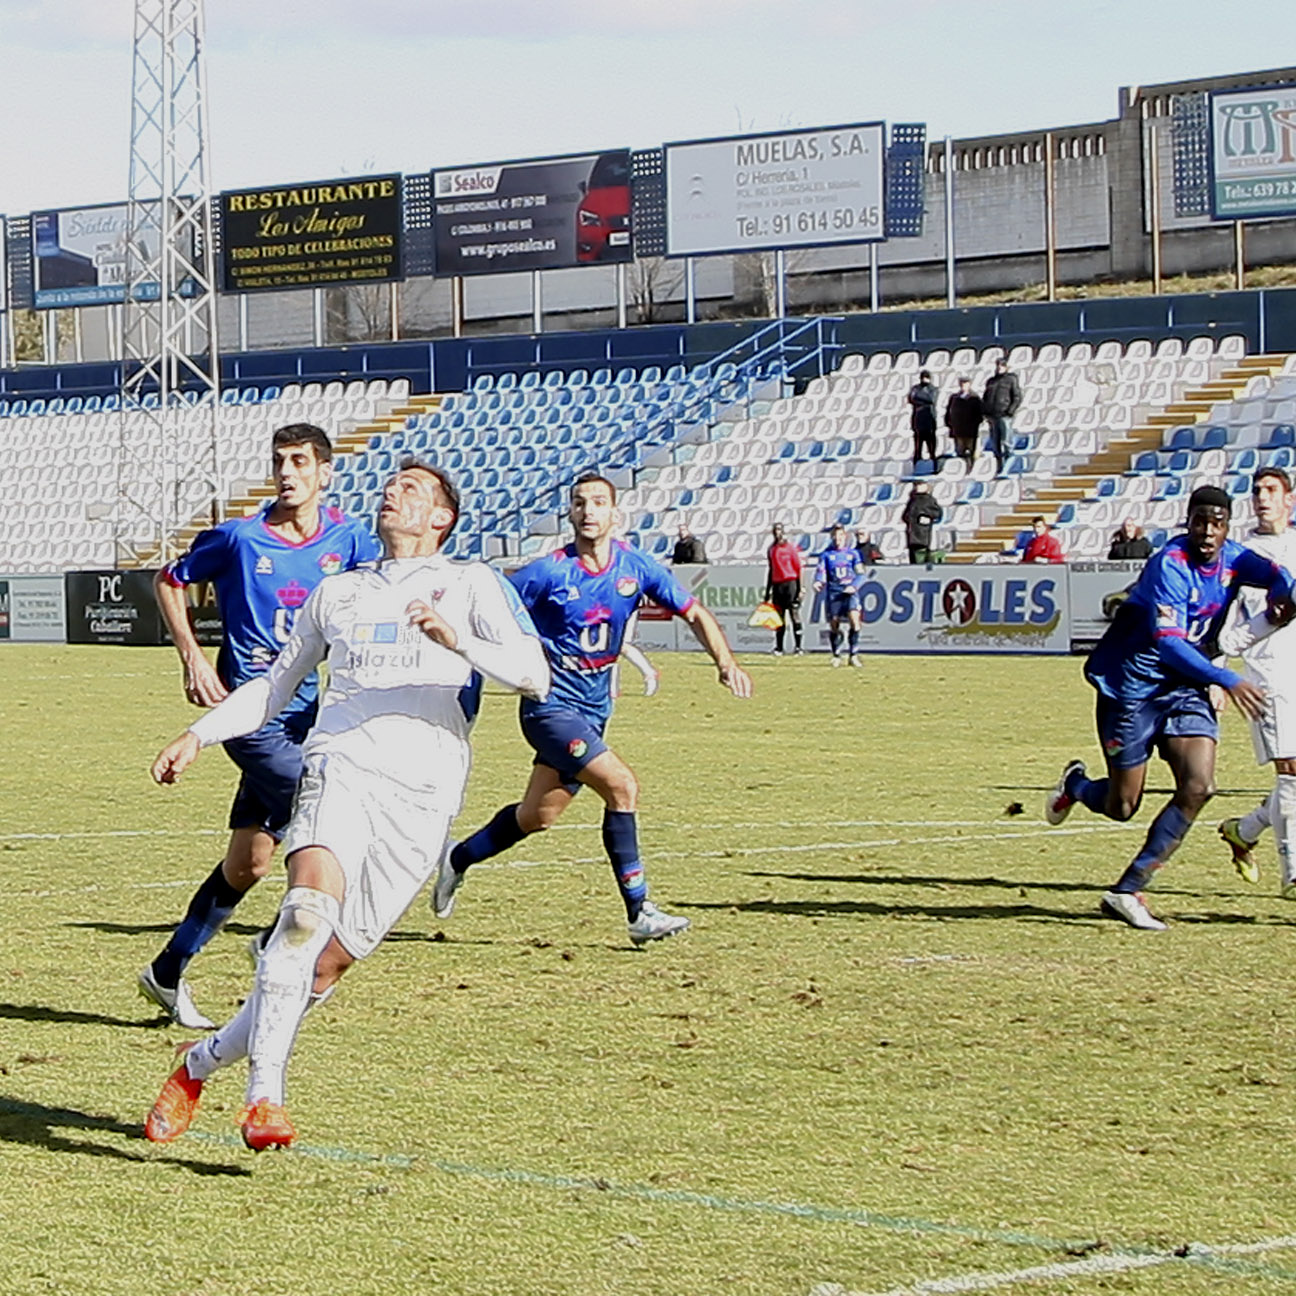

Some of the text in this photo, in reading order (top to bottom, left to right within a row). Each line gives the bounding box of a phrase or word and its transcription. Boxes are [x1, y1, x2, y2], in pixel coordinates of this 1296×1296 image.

[229, 180, 395, 212] RESTAURANTE
[772, 214, 791, 234] 91
[797, 211, 828, 232] 614
[833, 209, 853, 229] 50
[859, 206, 879, 226] 45
[98, 575, 124, 602] PC
